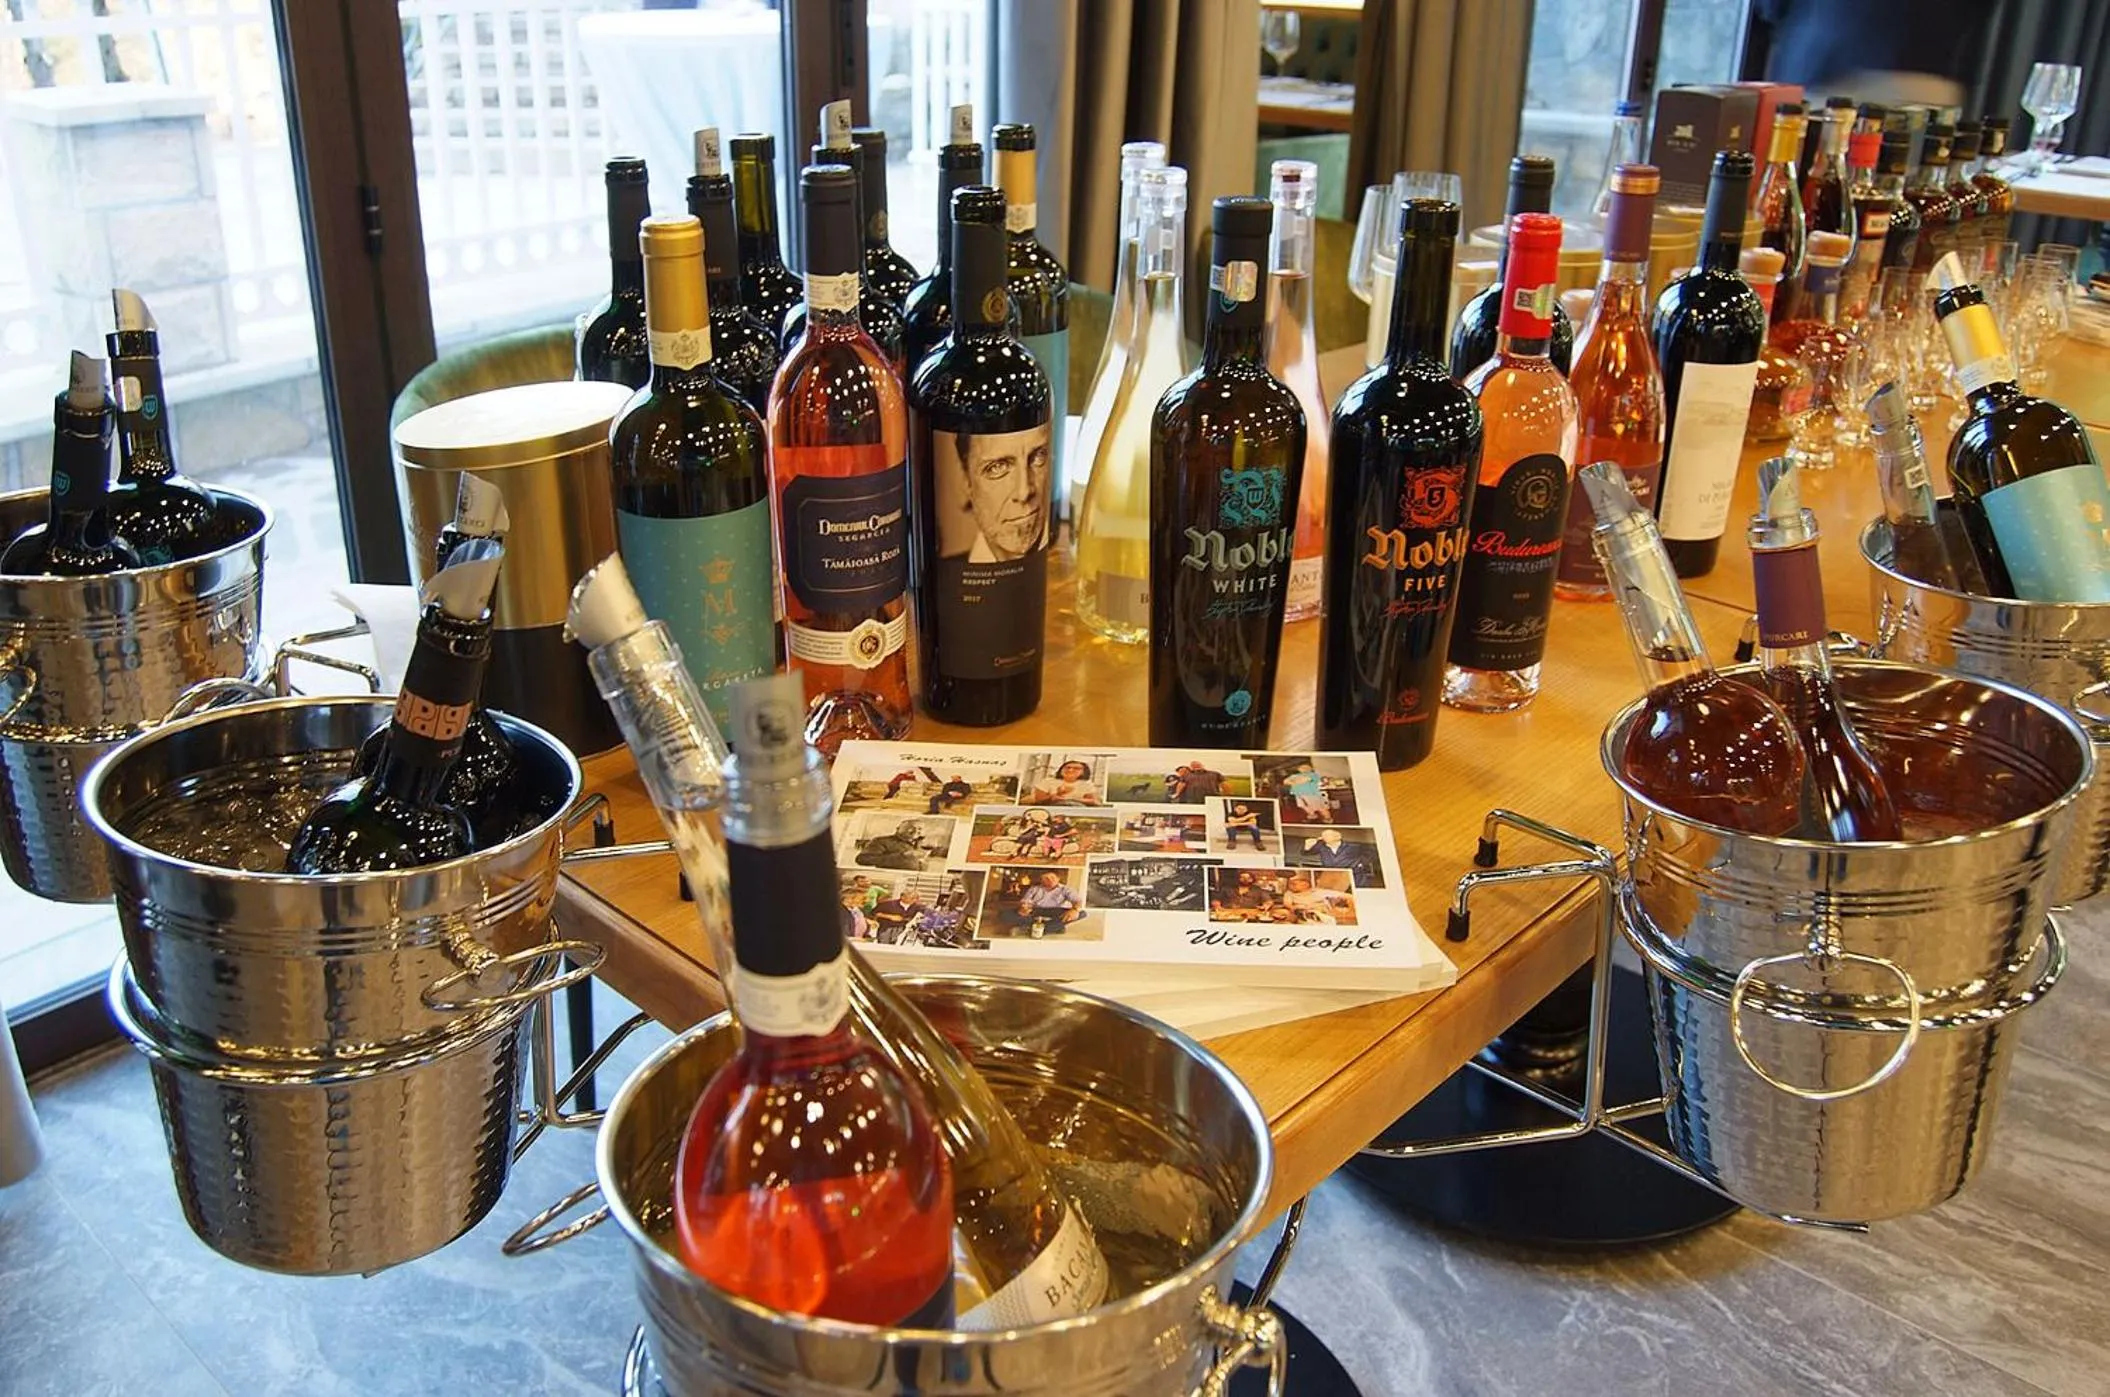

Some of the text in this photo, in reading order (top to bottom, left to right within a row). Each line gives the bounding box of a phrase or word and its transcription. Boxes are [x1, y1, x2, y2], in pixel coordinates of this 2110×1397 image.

[1472, 531, 1564, 556] Budurea
[1212, 574, 1278, 593] WHITE
[1404, 575, 1447, 592] FIVE
[1186, 929, 1384, 952] Wine people
